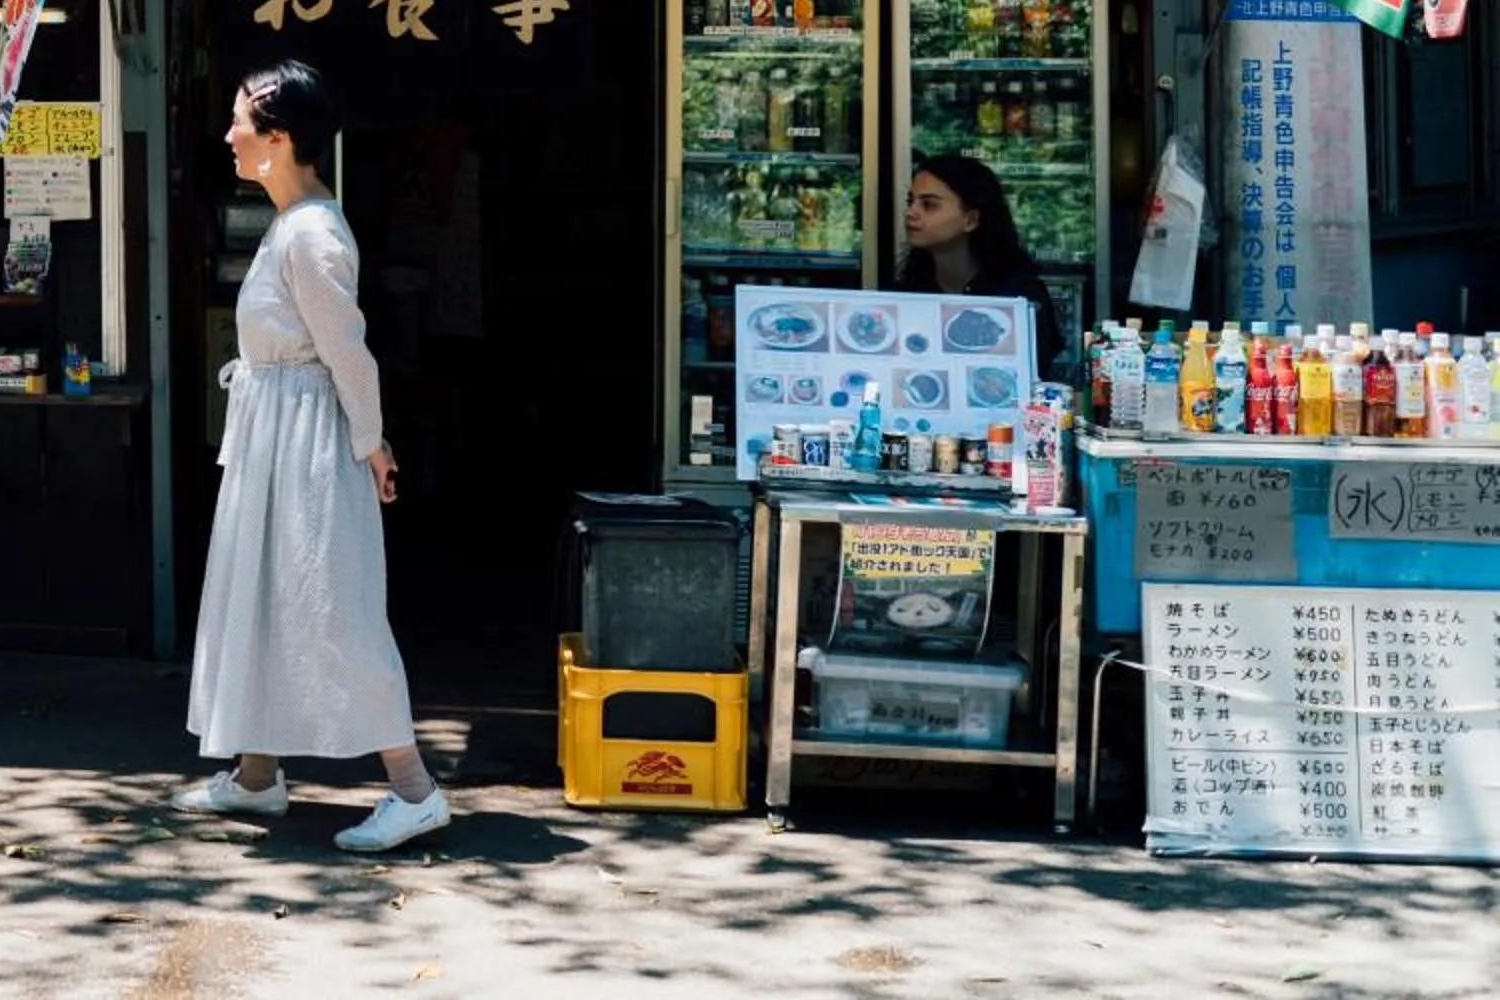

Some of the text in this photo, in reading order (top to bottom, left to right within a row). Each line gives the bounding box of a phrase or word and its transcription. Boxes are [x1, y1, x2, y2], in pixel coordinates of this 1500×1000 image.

[1273, 40, 1295, 252] 上野青色申告会は
[1150, 544, 1193, 557] モナカ
[1166, 602, 1341, 621] 焼そば ¥450
[1366, 608, 1465, 623] たぬきうどん
[1167, 624, 1341, 642] ラーメン ¥500
[1367, 631, 1466, 646] きつねうどん
[1168, 645, 1271, 660] わかめラーメン
[1367, 652, 1451, 668] 五目うどん
[1367, 673, 1436, 688] 肉うどん
[1370, 718, 1470, 733] 玉子とじうどん
[1171, 729, 1269, 744] カレーライス
[1370, 739, 1445, 754] 日本そば
[1371, 760, 1444, 776] ざるそば
[1300, 782, 1346, 797] ¥400
[1173, 800, 1346, 819] おでん ¥500
